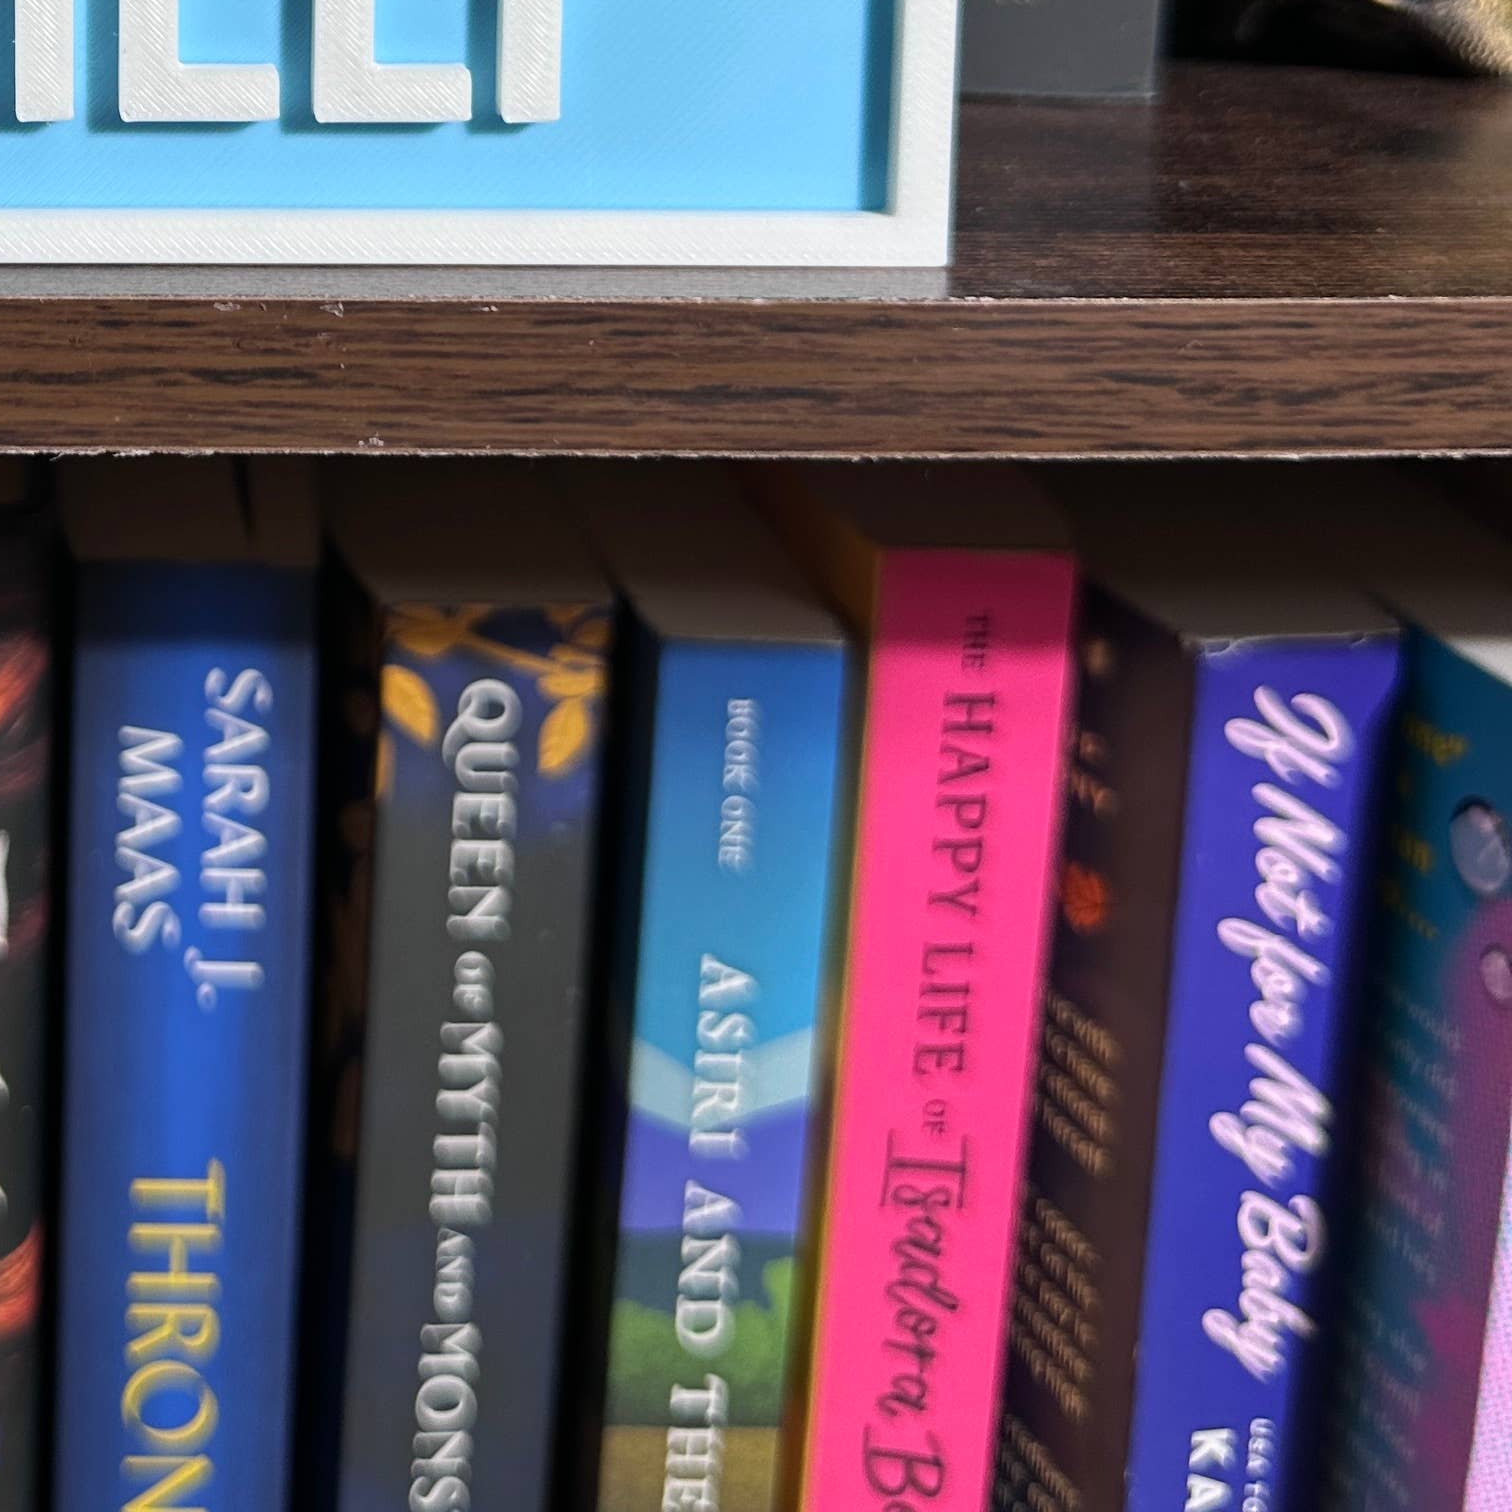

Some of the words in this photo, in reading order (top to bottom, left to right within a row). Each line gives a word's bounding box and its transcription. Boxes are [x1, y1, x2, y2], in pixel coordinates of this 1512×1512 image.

[959, 609, 995, 674] THE
[197, 665, 273, 931] SARAH
[442, 678, 523, 943] QUEEN
[722, 697, 761, 796] BOOK
[925, 691, 999, 917] HAPPY
[1223, 684, 1356, 792] If
[112, 723, 186, 956] MAAS
[717, 794, 756, 875] ONE
[1249, 781, 1346, 940] Not
[184, 944, 266, 1011] J.
[452, 950, 496, 1014] OF
[911, 941, 976, 1080] LIFE
[1216, 916, 1333, 1040] for
[429, 1021, 504, 1228] MYTH
[688, 952, 760, 1162] ASIRI
[921, 1098, 948, 1137] OF
[1207, 1042, 1334, 1190] My
[433, 1228, 476, 1323] AND
[675, 1179, 742, 1358] AND
[875, 1127, 968, 1418] Isadora
[1202, 1188, 1326, 1384] Baby
